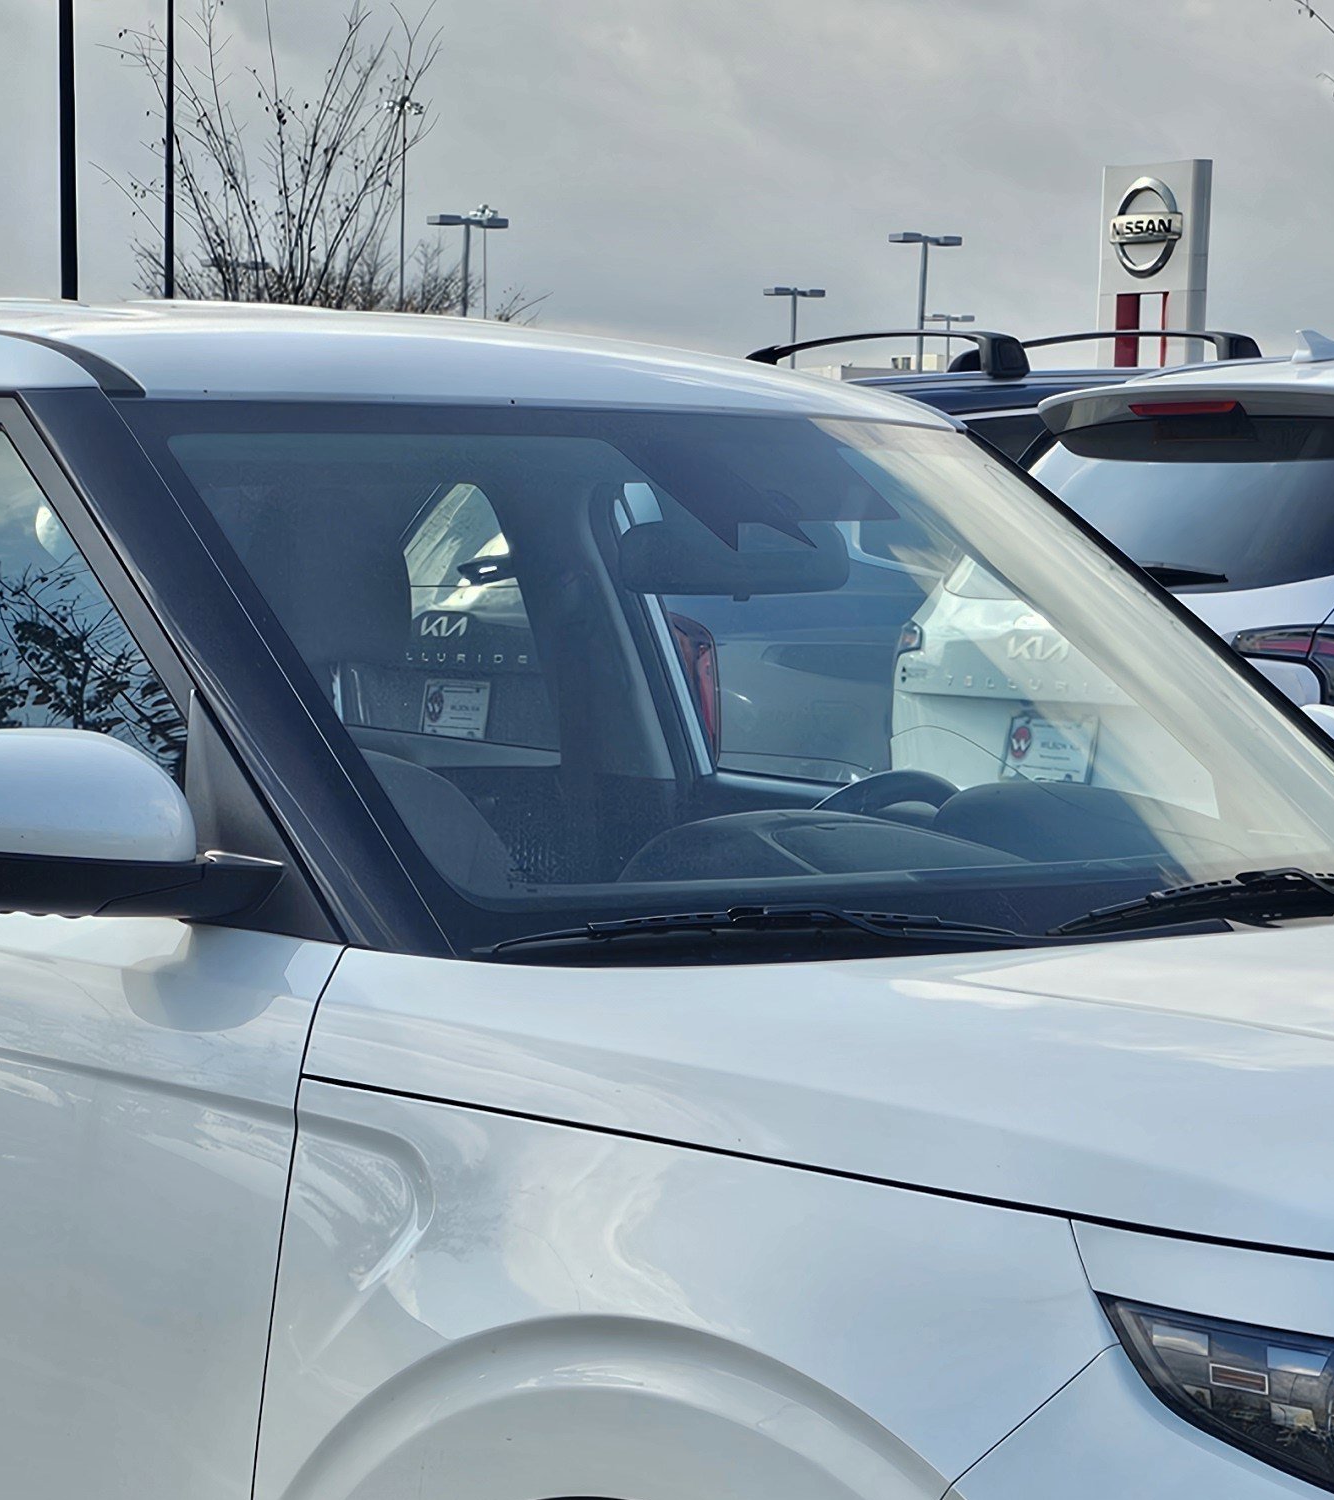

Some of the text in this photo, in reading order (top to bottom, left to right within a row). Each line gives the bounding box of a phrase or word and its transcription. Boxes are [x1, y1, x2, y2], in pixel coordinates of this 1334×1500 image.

[1112, 218, 1173, 236] NISSAN
[420, 616, 468, 637] KIA
[405, 652, 529, 664] LLURIDE
[1007, 635, 1069, 663] KIA
